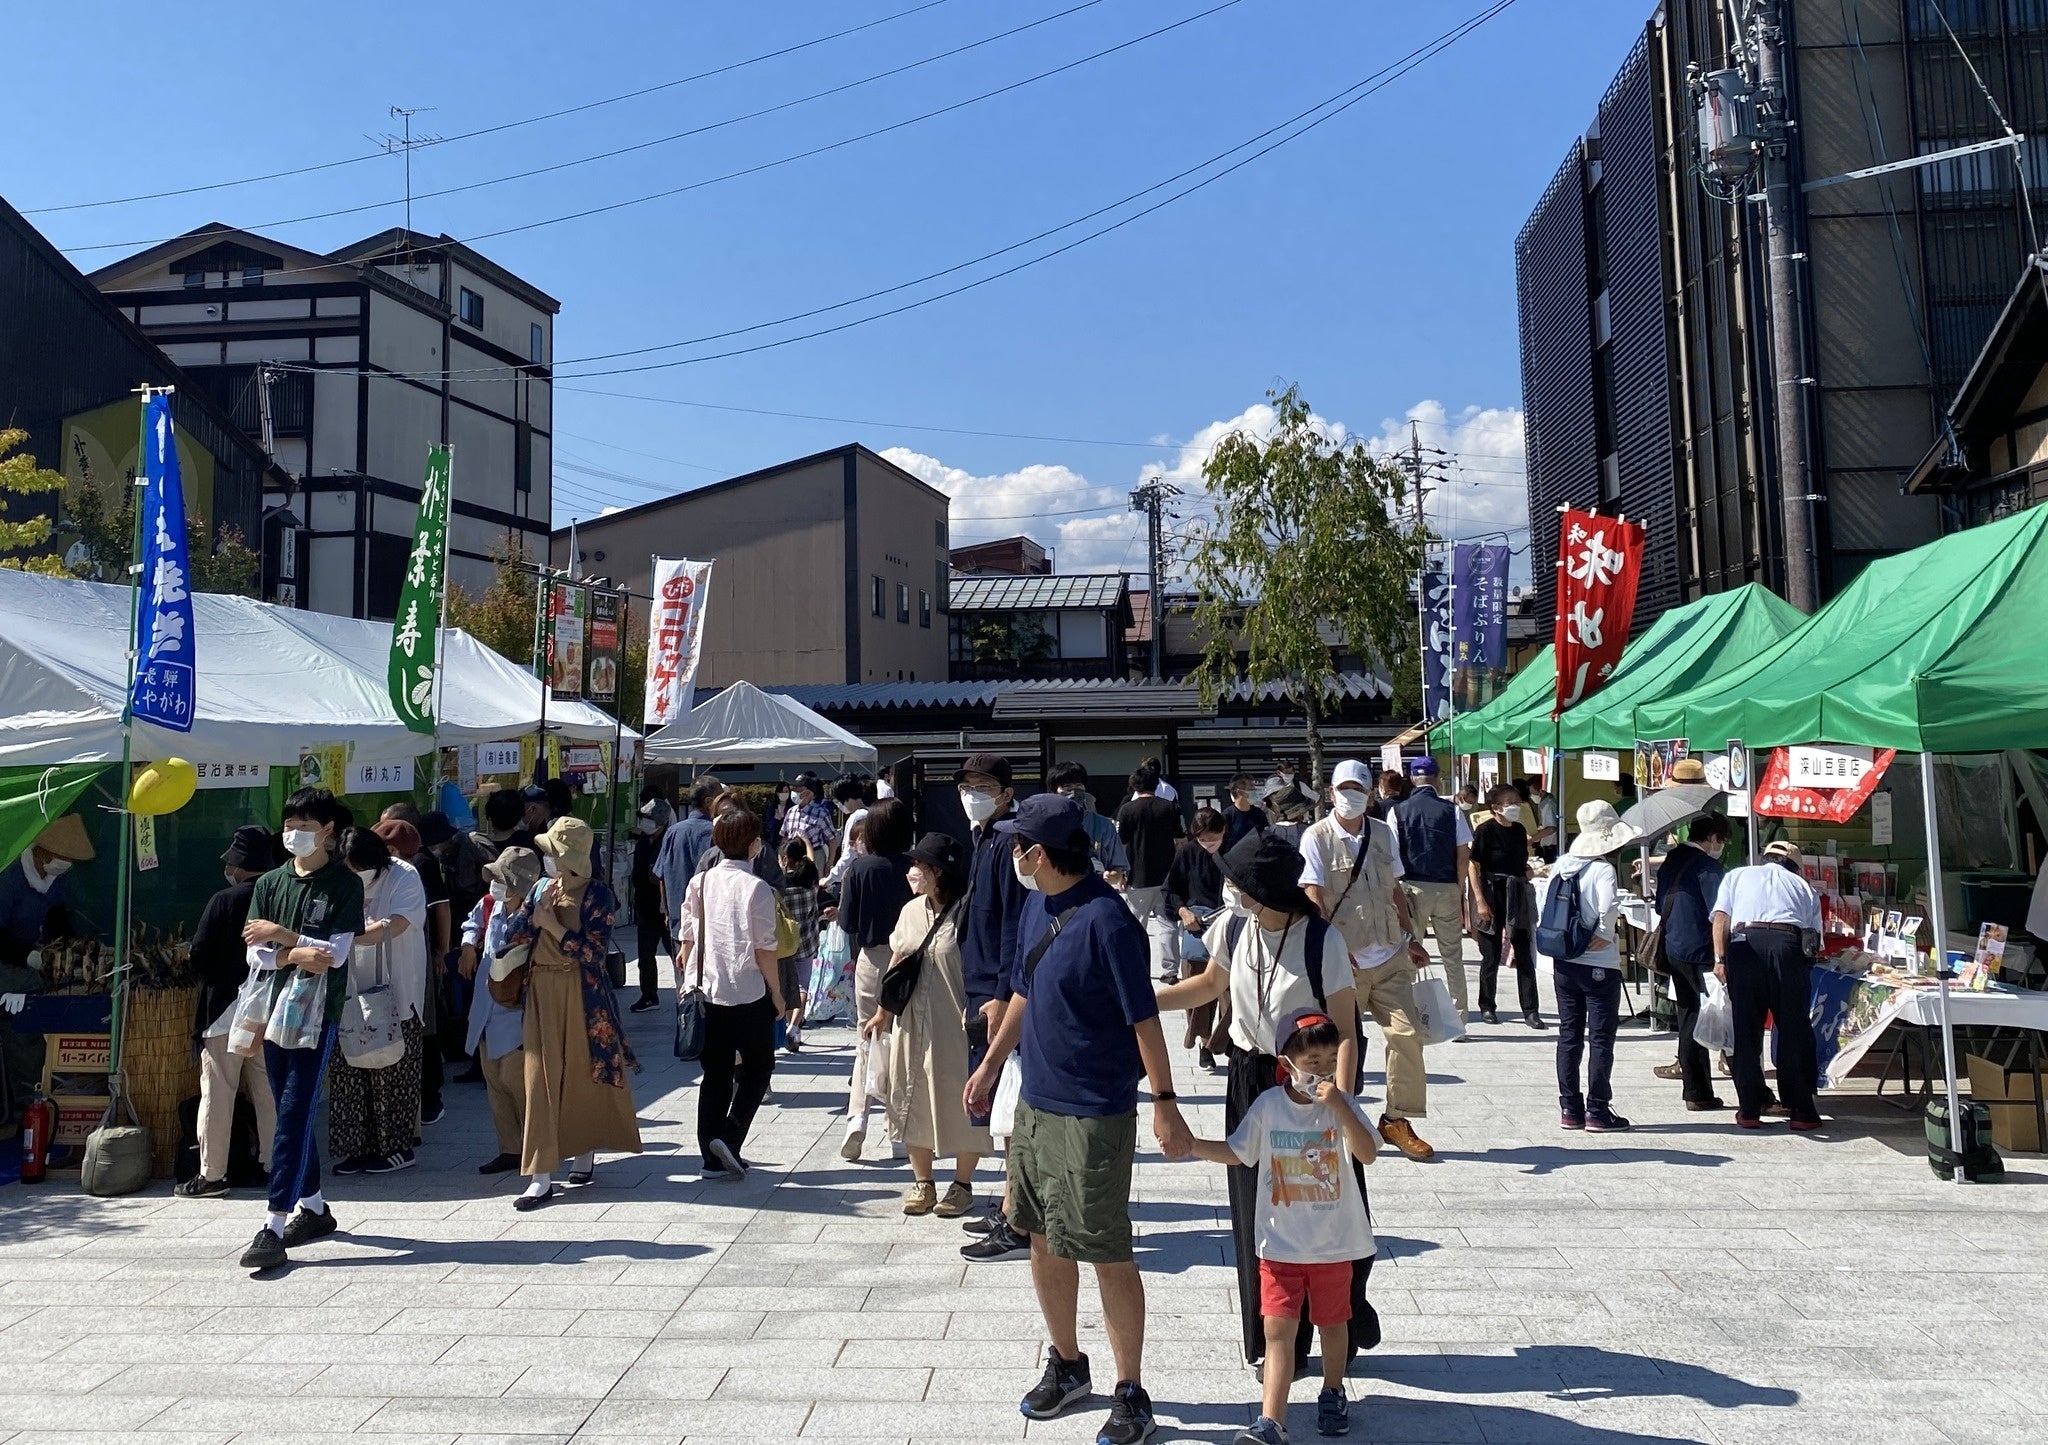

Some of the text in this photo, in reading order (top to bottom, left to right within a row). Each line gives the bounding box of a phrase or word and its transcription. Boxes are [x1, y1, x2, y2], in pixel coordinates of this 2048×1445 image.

[396, 466, 440, 720] 朴葉寿し
[1472, 576, 1489, 664] そばぷりん
[1492, 576, 1504, 625] 数量限定
[653, 601, 690, 692] コロッケ
[1459, 641, 1469, 662] 極み
[135, 689, 186, 716] やがわ
